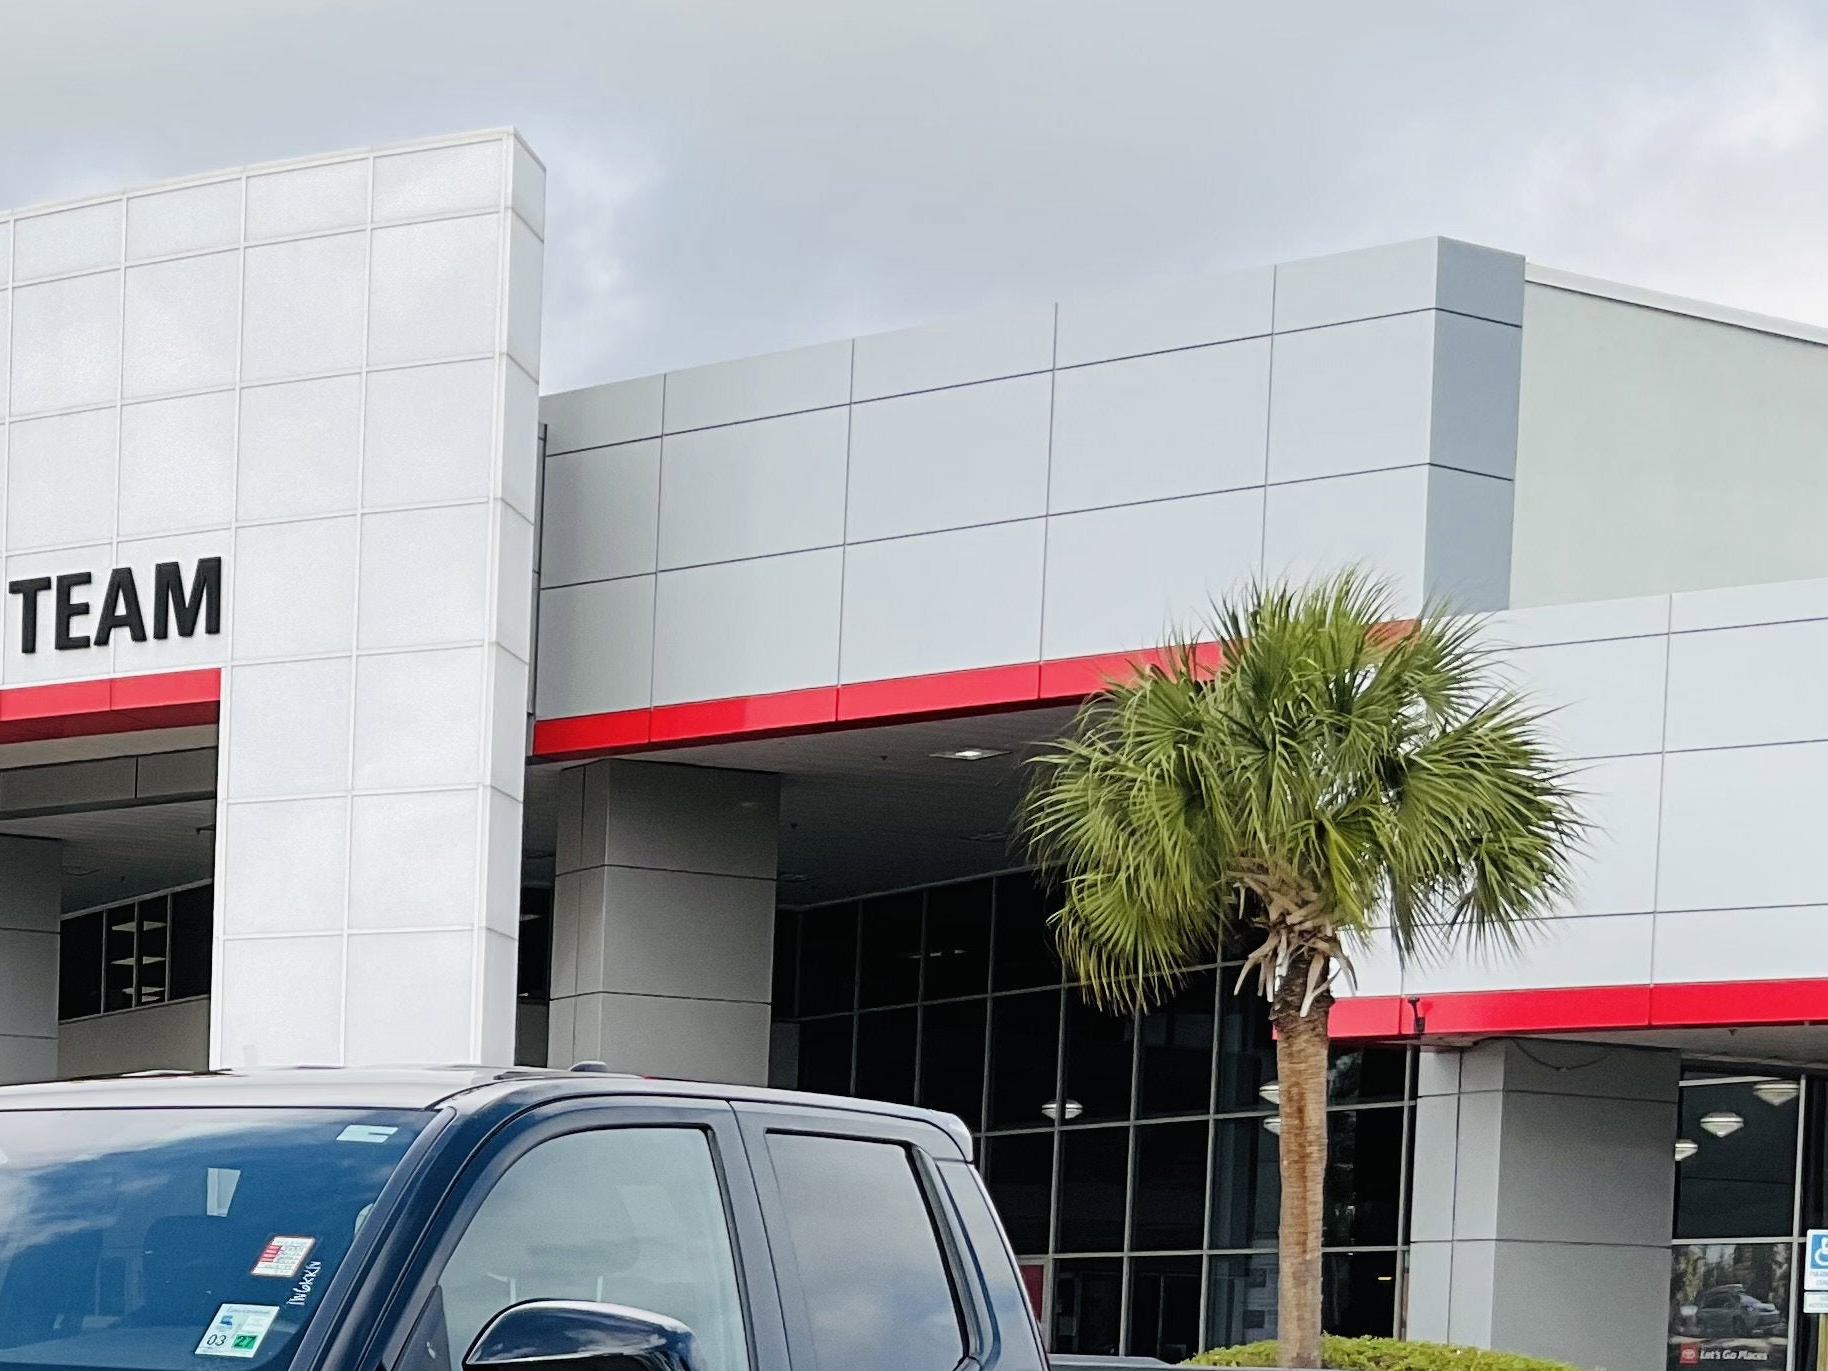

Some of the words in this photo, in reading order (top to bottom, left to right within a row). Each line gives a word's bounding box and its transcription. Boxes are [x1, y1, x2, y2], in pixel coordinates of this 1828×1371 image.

[9, 556, 222, 654] TEAM
[206, 1334, 226, 1346] 03
[234, 1335, 257, 1347] 27
[1700, 1350, 1721, 1360] Let's
[1722, 1350, 1737, 1360] Go
[1738, 1350, 1768, 1360] Places
